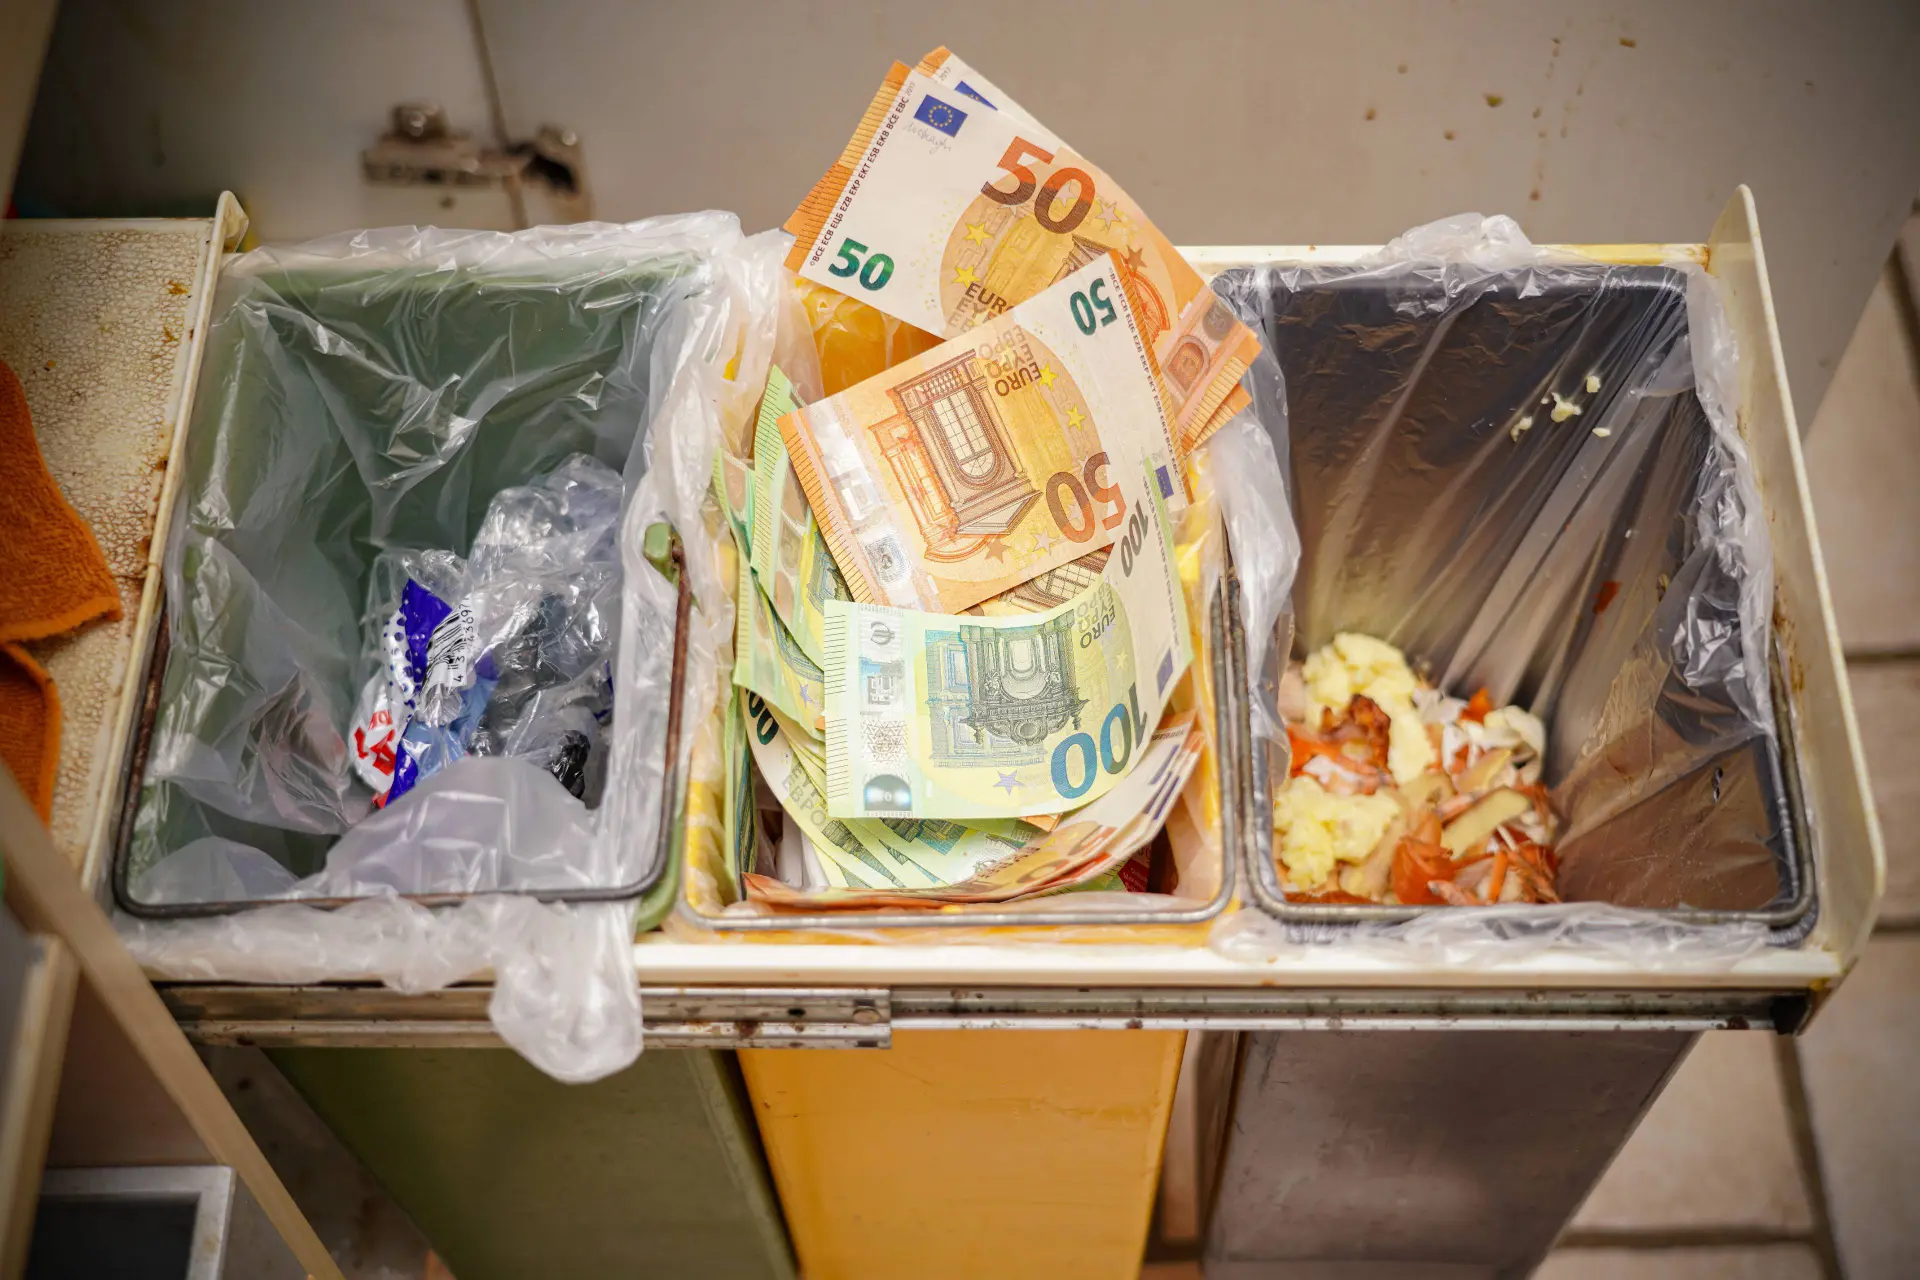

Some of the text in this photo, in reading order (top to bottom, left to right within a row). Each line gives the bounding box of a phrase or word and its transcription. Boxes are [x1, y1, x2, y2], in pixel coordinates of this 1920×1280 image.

[820, 228, 834, 245] ECB
[839, 195, 852, 212] EZB
[848, 178, 862, 196] EKP
[857, 162, 871, 179] EKT
[866, 146, 880, 163] ESB
[875, 129, 889, 147] EKB
[895, 96, 909, 113] EBC
[904, 81, 916, 96] 2017
[980, 136, 1096, 235] 50
[827, 237, 894, 291] 50
[965, 282, 1015, 315] EUR
[1070, 276, 1118, 337] 50
[994, 361, 1042, 397] EURO
[1046, 451, 1127, 543] 50
[1120, 499, 1149, 578] 100
[1080, 604, 1116, 649] EURO
[745, 688, 779, 745] 00
[1050, 681, 1147, 799] 100
